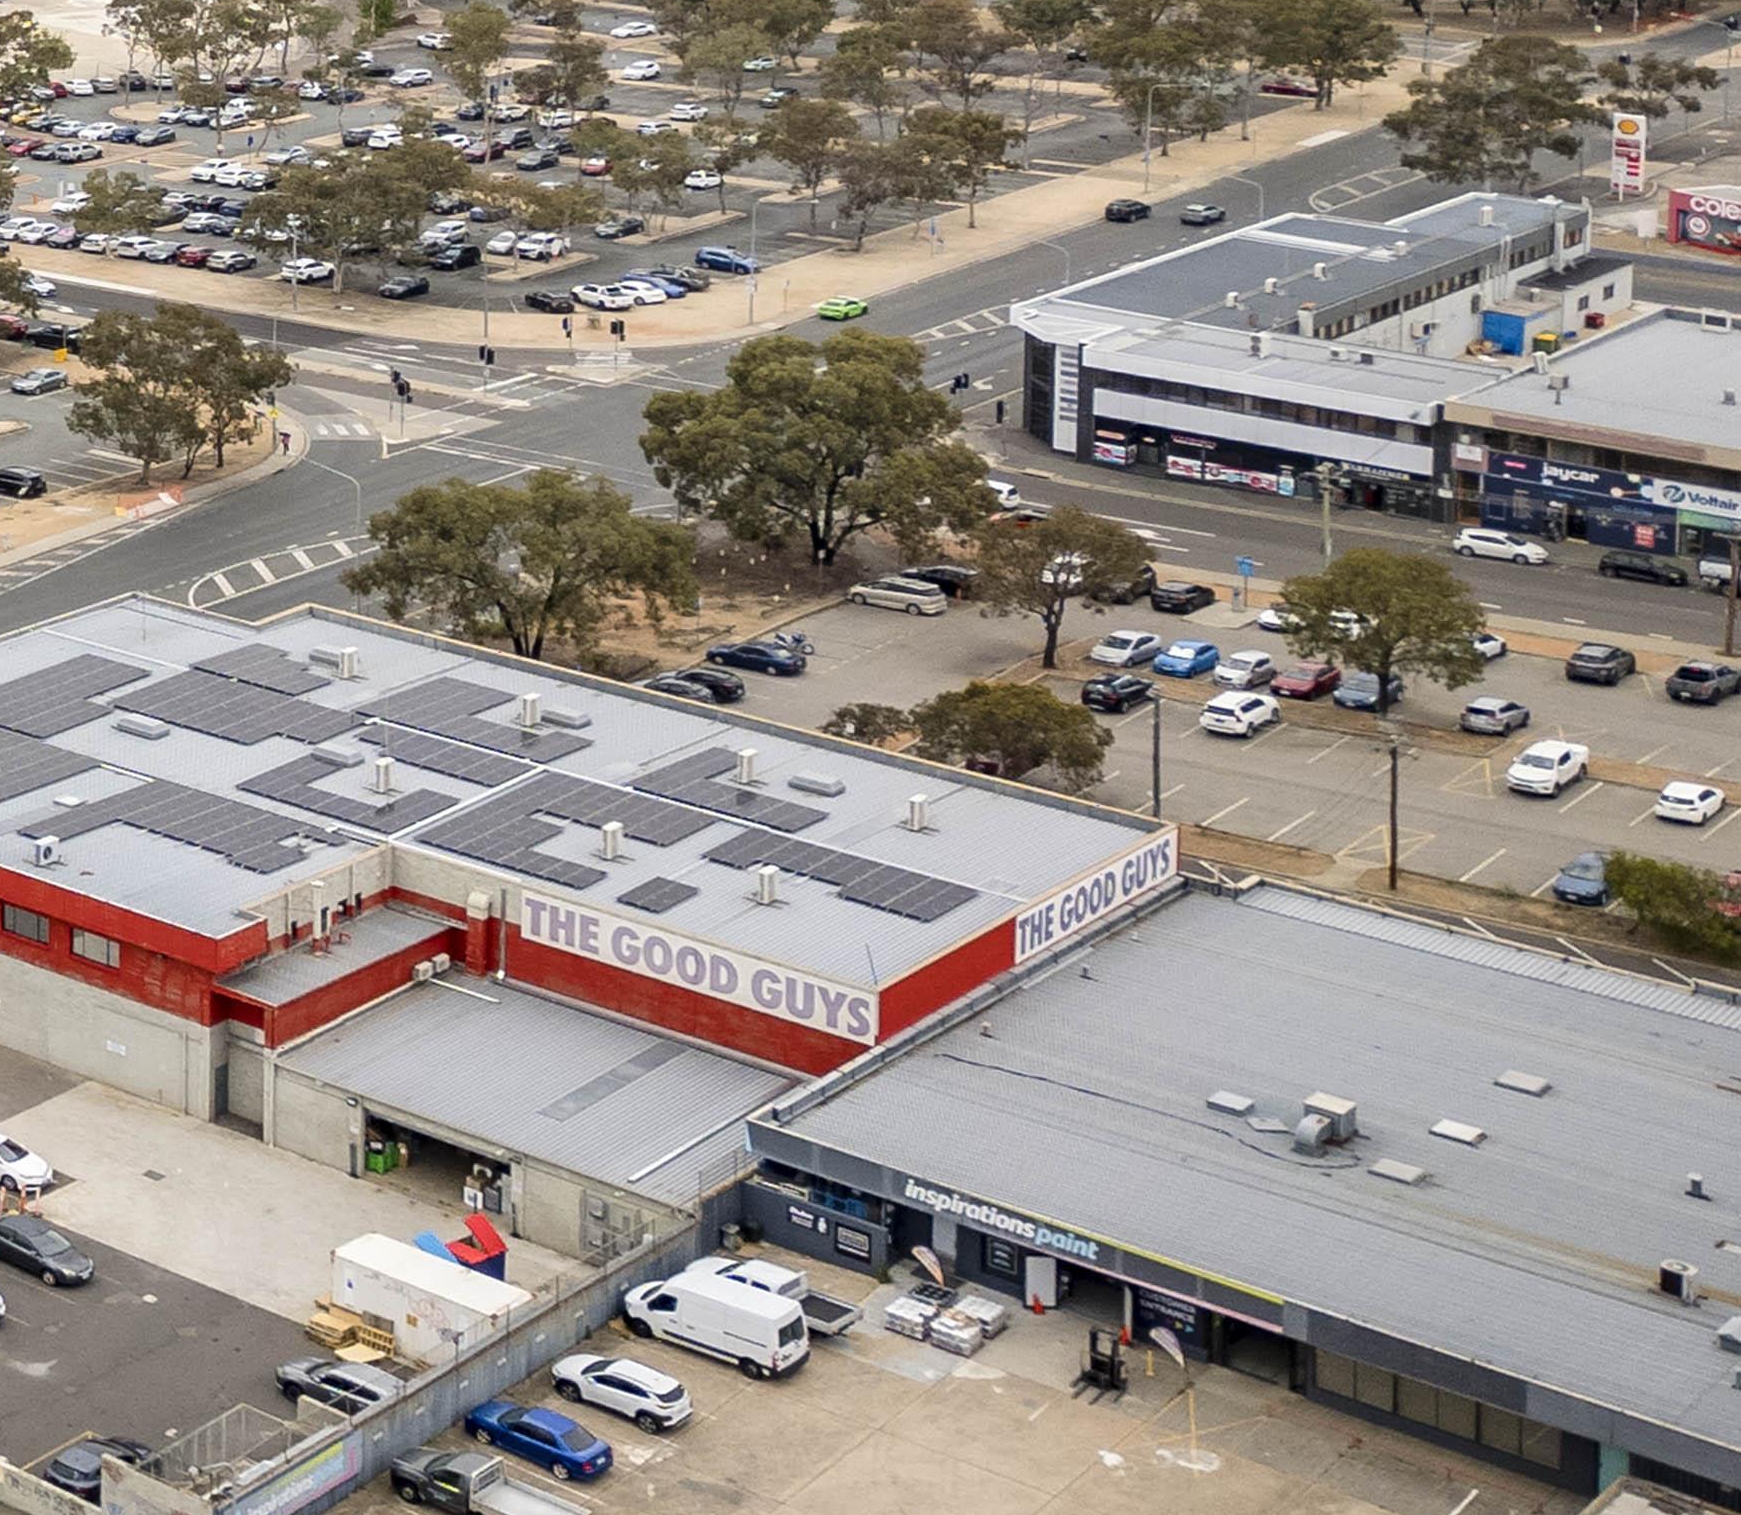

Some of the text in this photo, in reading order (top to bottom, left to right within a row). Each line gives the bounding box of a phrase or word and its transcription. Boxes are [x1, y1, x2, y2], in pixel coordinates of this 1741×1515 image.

[1542, 462, 1600, 484] jaycar
[1019, 838, 1170, 954] THE GOOD GUYS
[524, 897, 871, 1036] THE GOOD GUYS
